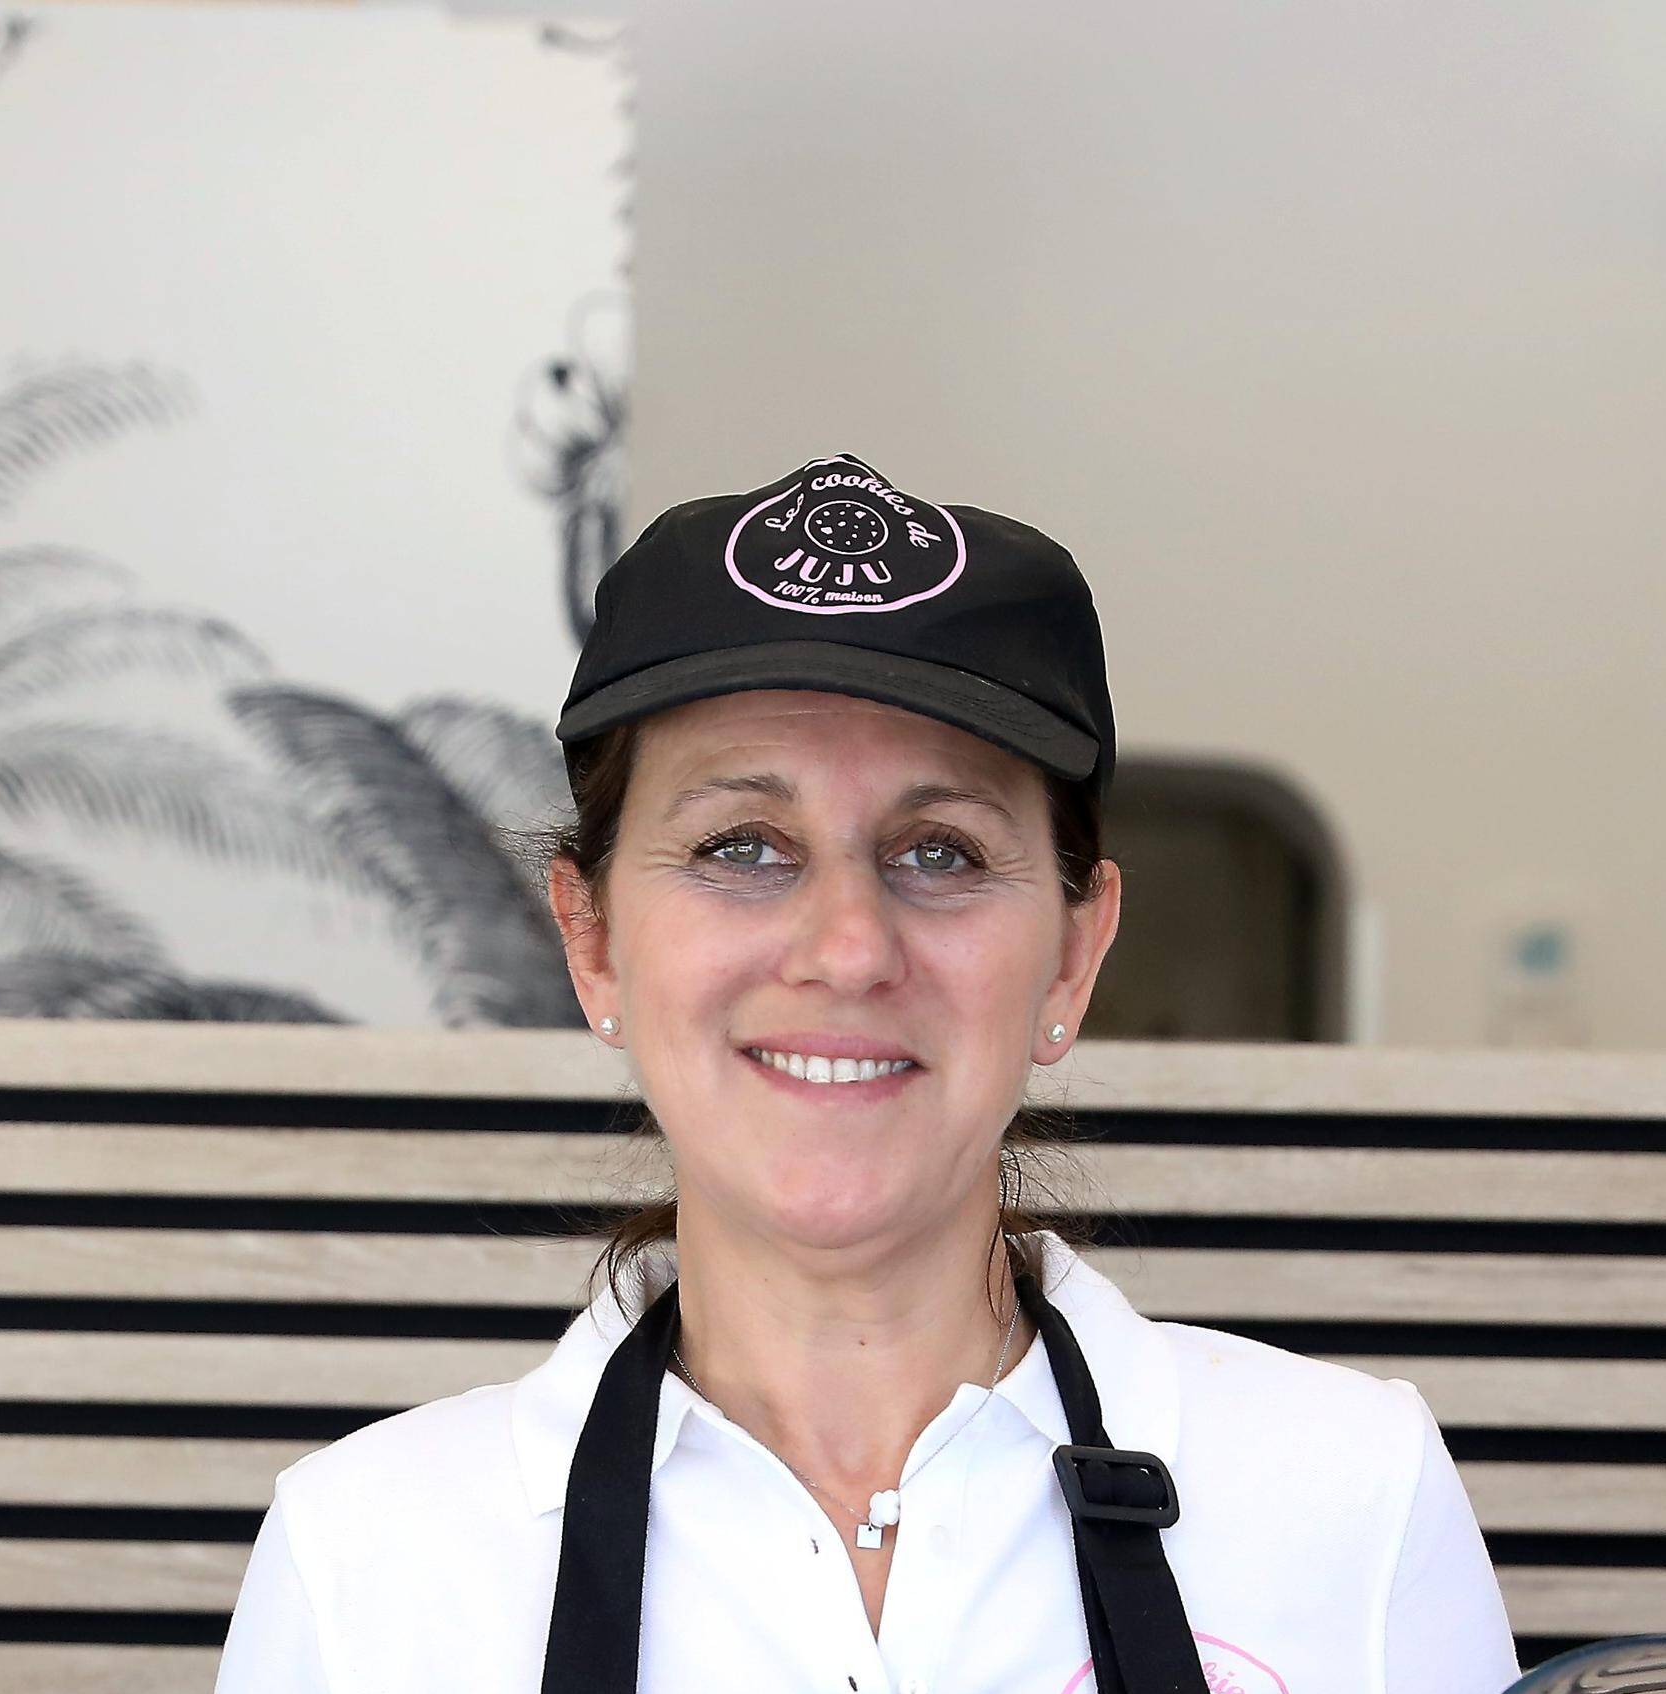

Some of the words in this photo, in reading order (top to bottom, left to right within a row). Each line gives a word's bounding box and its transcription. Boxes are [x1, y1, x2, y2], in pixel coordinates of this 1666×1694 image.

[764, 493, 805, 532] Les
[810, 473, 916, 517] cookies
[905, 519, 942, 549] de
[773, 548, 893, 586] JUJU
[772, 580, 823, 604] 100%
[824, 591, 884, 603] maison
